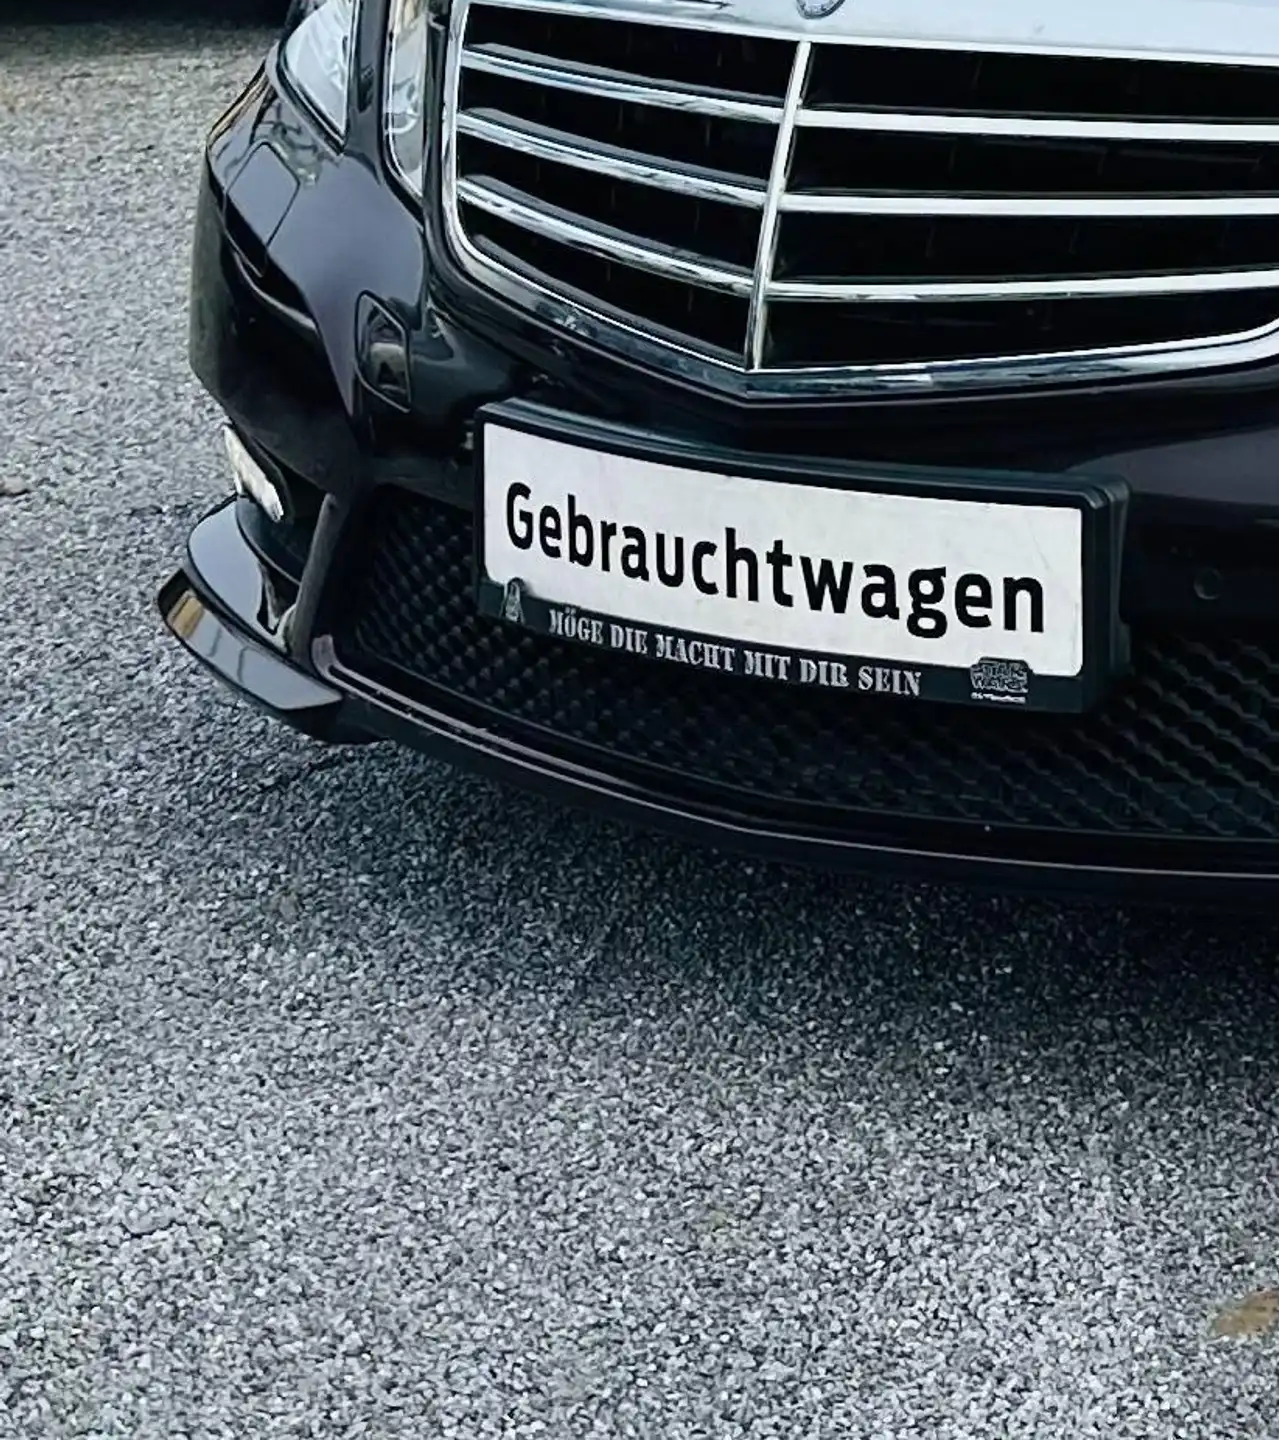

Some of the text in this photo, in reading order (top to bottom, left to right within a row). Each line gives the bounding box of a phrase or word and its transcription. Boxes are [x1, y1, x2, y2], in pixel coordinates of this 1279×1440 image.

[505, 482, 1045, 639] Gebrauchtwagen
[549, 608, 922, 696] MÖGE DIE MACHT MIT DIR SEIN
